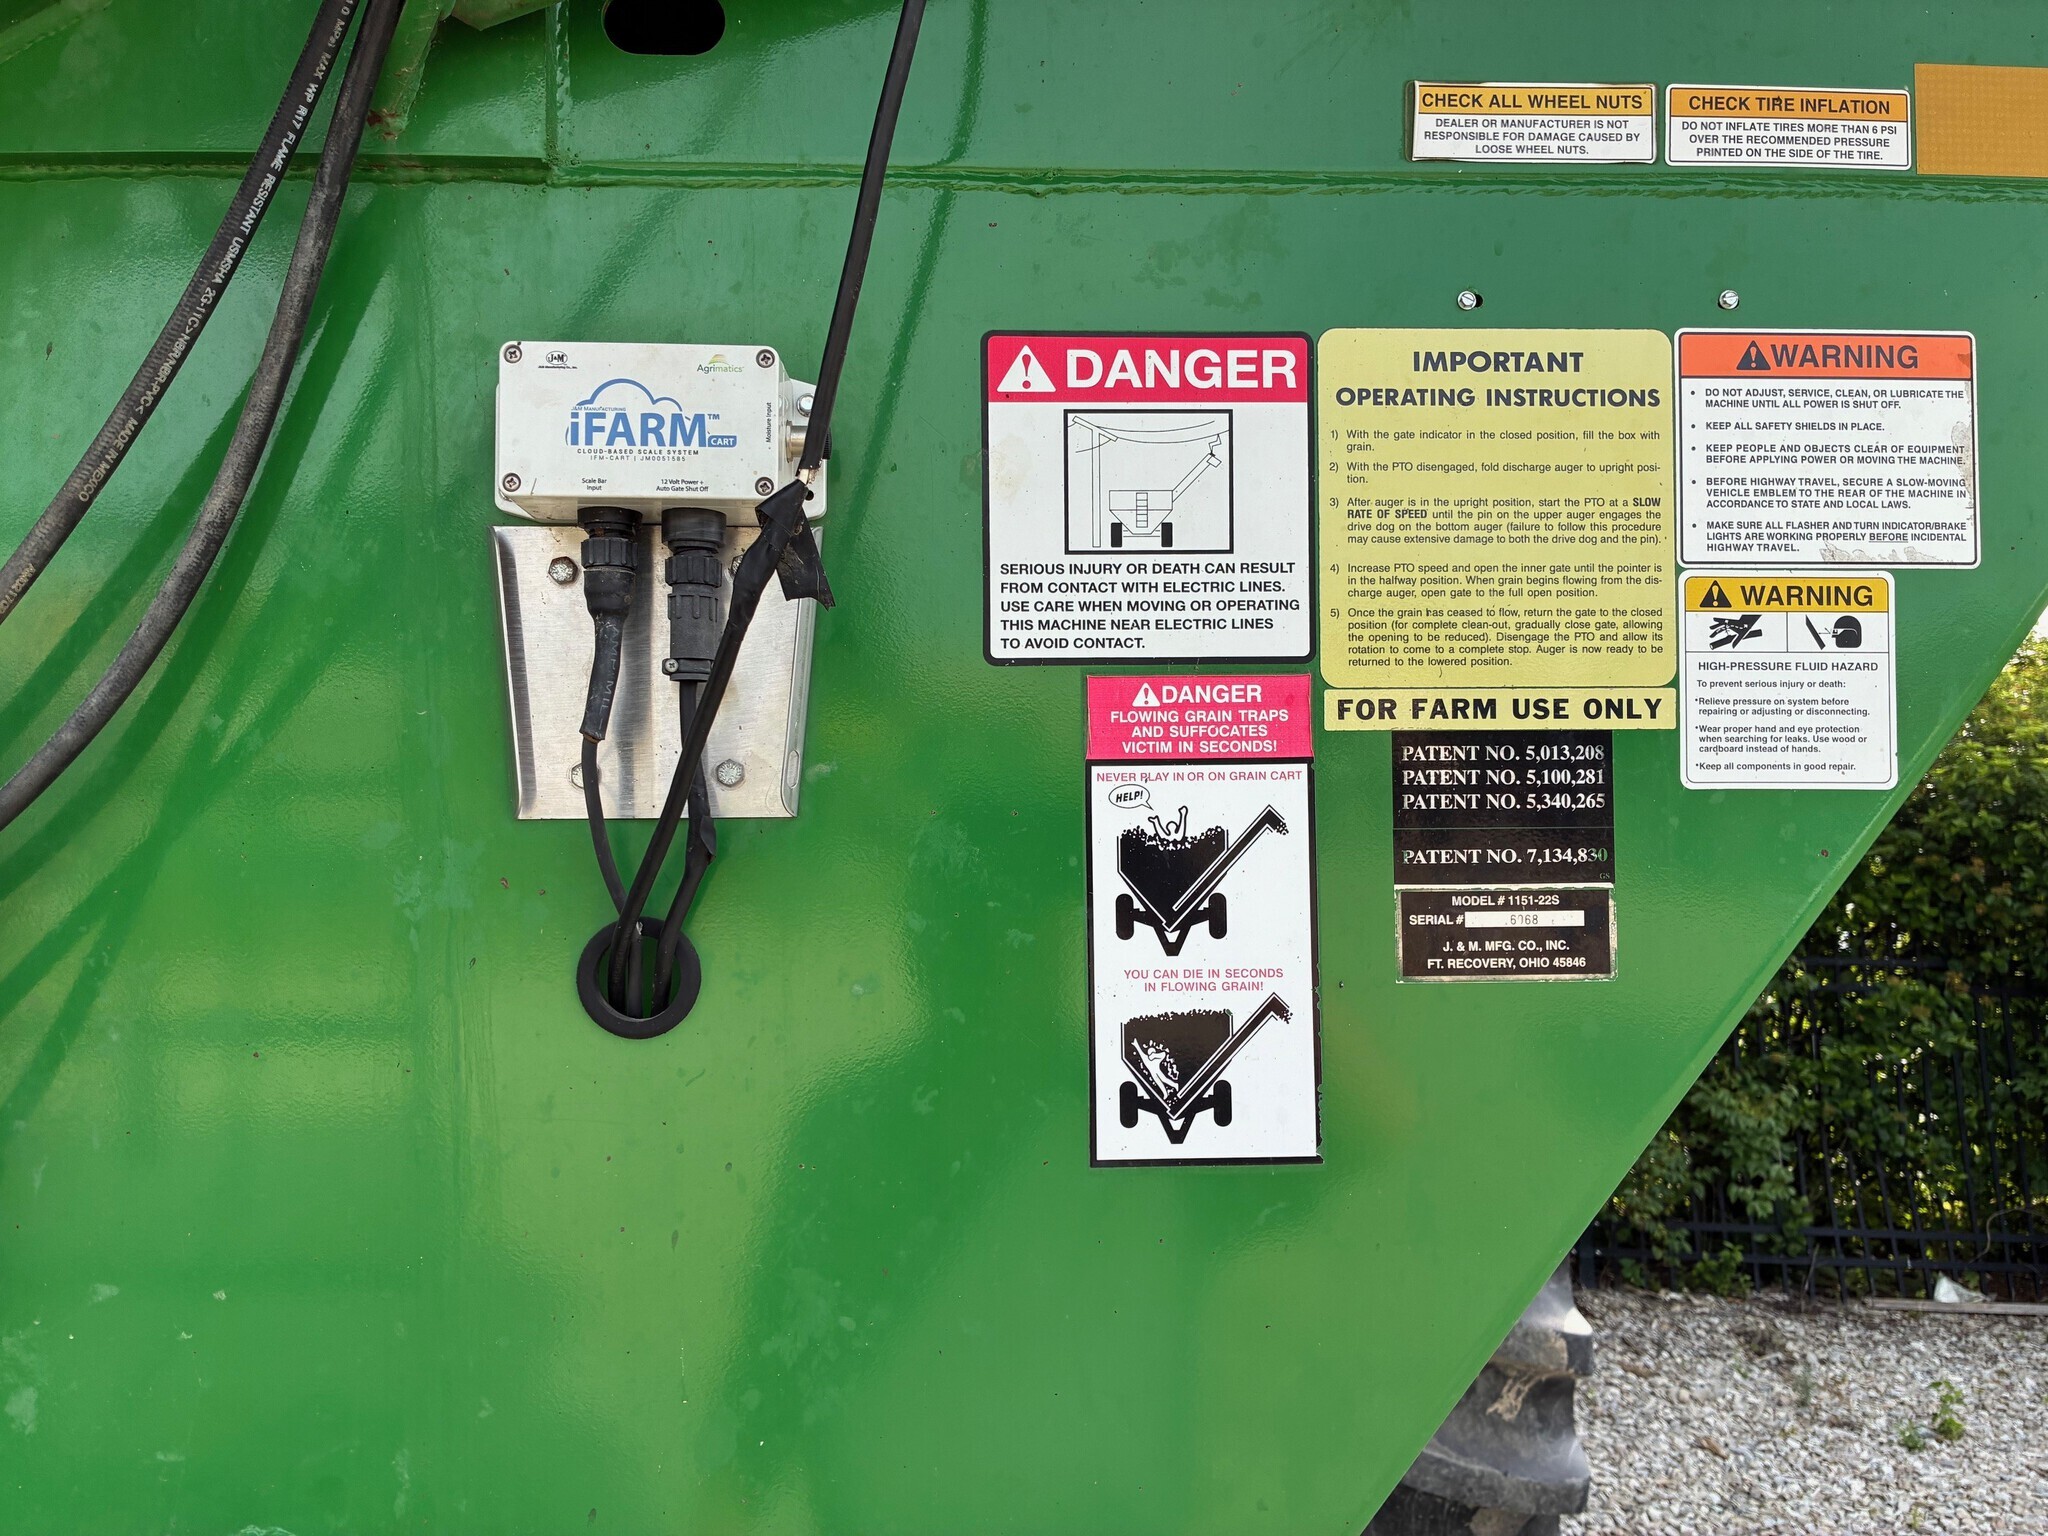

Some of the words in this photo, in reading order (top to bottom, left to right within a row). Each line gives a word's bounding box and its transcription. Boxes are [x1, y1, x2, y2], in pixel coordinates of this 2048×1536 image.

[304, 82, 318, 103] WP
[1422, 93, 1483, 107] CHECK
[1489, 94, 1522, 108] ALL
[1528, 95, 1590, 108] WHEEL
[1596, 95, 1642, 109] NUTS
[1689, 96, 1750, 110] CHECK
[1755, 96, 1795, 111] TIRE
[1801, 98, 1889, 114] INFLATION
[292, 104, 308, 130] R17
[1436, 118, 1478, 128] DEALER
[1482, 119, 1497, 128] OR
[1501, 119, 1590, 128] MANUFACTURER
[1594, 120, 1604, 129] IS
[1607, 120, 1629, 129] NOT
[1682, 121, 1698, 130] DO
[1701, 121, 1723, 130] NOT
[1726, 122, 1770, 131] INFLATE
[1773, 123, 1804, 132] TIRES
[1807, 124, 1838, 133] MORE
[1841, 124, 1869, 134] THAN
[1872, 126, 1878, 134] 6
[1881, 126, 1896, 135] PSI
[270, 131, 296, 172] FLAME
[1476, 145, 1512, 154] LOOSE
[1515, 145, 1554, 154] WHEEL
[1557, 145, 1589, 154] NUTS.
[239, 172, 277, 236] RESISTANT
[212, 236, 244, 285] USMSHA
[1414, 351, 1584, 372] IMPORTANT
[1770, 344, 1918, 369] WARNING
[697, 363, 742, 374] Agrimatics
[1067, 349, 1296, 388] DANGER
[1336, 387, 1475, 406] OPERATING
[1487, 388, 1660, 407] INSTRUCTIONS
[1705, 388, 1719, 396] DO
[1723, 388, 1742, 396] NOT
[1745, 388, 1786, 398] ADJUST,
[1788, 388, 1832, 398] SERVICE,
[1835, 389, 1871, 398] CLEAN,
[1873, 389, 1887, 398] OR
[1890, 390, 1943, 398] LUBRICATE
[1706, 422, 1731, 430] KEEP
[1734, 422, 1752, 430] ALL
[1755, 422, 1792, 430] SAFETY
[1795, 422, 1836, 430] SHIELDS
[1851, 423, 1884, 431] PLACE.
[116, 416, 139, 451] MADE
[1331, 430, 1338, 441] 1)
[1346, 430, 1369, 438] With
[1374, 430, 1389, 439] the
[1394, 431, 1415, 441] gate
[1420, 430, 1462, 439] indicator
[1467, 430, 1475, 439] in
[1480, 430, 1495, 439] the
[1500, 430, 1532, 439] closed
[1537, 430, 1578, 441] position,
[1583, 431, 1594, 439] fill
[1598, 431, 1614, 440] the
[1618, 431, 1636, 440] box
[1640, 431, 1660, 440] with
[1347, 442, 1374, 453] grain.
[105, 451, 119, 464] IN
[1706, 455, 1746, 463] BEFORE
[1749, 455, 1798, 464] APPLYING
[1801, 455, 1836, 464] POWER
[1857, 456, 1895, 464] MOVING
[1920, 456, 1966, 465] MACHINE.
[79, 462, 111, 502] MEXICO
[1000, 564, 1064, 575] SERIOUS
[1069, 564, 1122, 574] INJURY
[1126, 563, 1147, 574] OR
[1152, 563, 1200, 574] DEATH
[1205, 563, 1235, 574] CAN
[1240, 562, 1295, 574] RESULT
[1001, 582, 1043, 593] FROM
[1048, 582, 1117, 593] CONTACT
[1121, 582, 1158, 593] WITH
[1163, 581, 1235, 593] ELECTRIC
[1240, 581, 1285, 592] LINES.
[1740, 586, 1872, 606] WARNING
[1699, 662, 1792, 671] HIGH-PRESSURE
[1795, 662, 1828, 671] FLUID
[1832, 662, 1878, 671] HAZARD
[1710, 680, 1742, 689] prevent
[1780, 680, 1804, 689] injury
[1162, 685, 1261, 703] DANGER
[1338, 699, 1397, 720] FOR
[1412, 698, 1496, 719] FARM
[1513, 698, 1569, 720] USE
[1584, 698, 1662, 719] ONLY
[1111, 710, 1179, 723] FLOWING
[1185, 710, 1232, 722] GRAIN
[1238, 709, 1288, 721] TRAPS
[1132, 726, 1163, 737] AND
[1170, 724, 1267, 737] SUFFOCATES
[1122, 741, 1172, 753] VICTIM
[1179, 741, 1193, 753] IN
[1200, 740, 1276, 753] SECONDS!
[1402, 746, 1479, 761] PATENT
[1485, 745, 1520, 760] NO.
[1526, 745, 1604, 763] 5,013,208
[1116, 790, 1143, 803] HELP!
[1452, 895, 1495, 906] MODEL
[1508, 895, 1559, 905] 1151-22S
[1409, 915, 1454, 925] SERIAL
[1428, 959, 1444, 969] FT.
[1448, 958, 1516, 969] RECOVERY,
[1519, 957, 1549, 968] OHIO
[1553, 957, 1586, 967] 45846
[1124, 970, 1148, 979] YOU
[1153, 969, 1178, 979] CAN
[1183, 969, 1203, 978] DIE
[1208, 969, 1220, 978] IN
[1225, 968, 1283, 978] SECONDS
